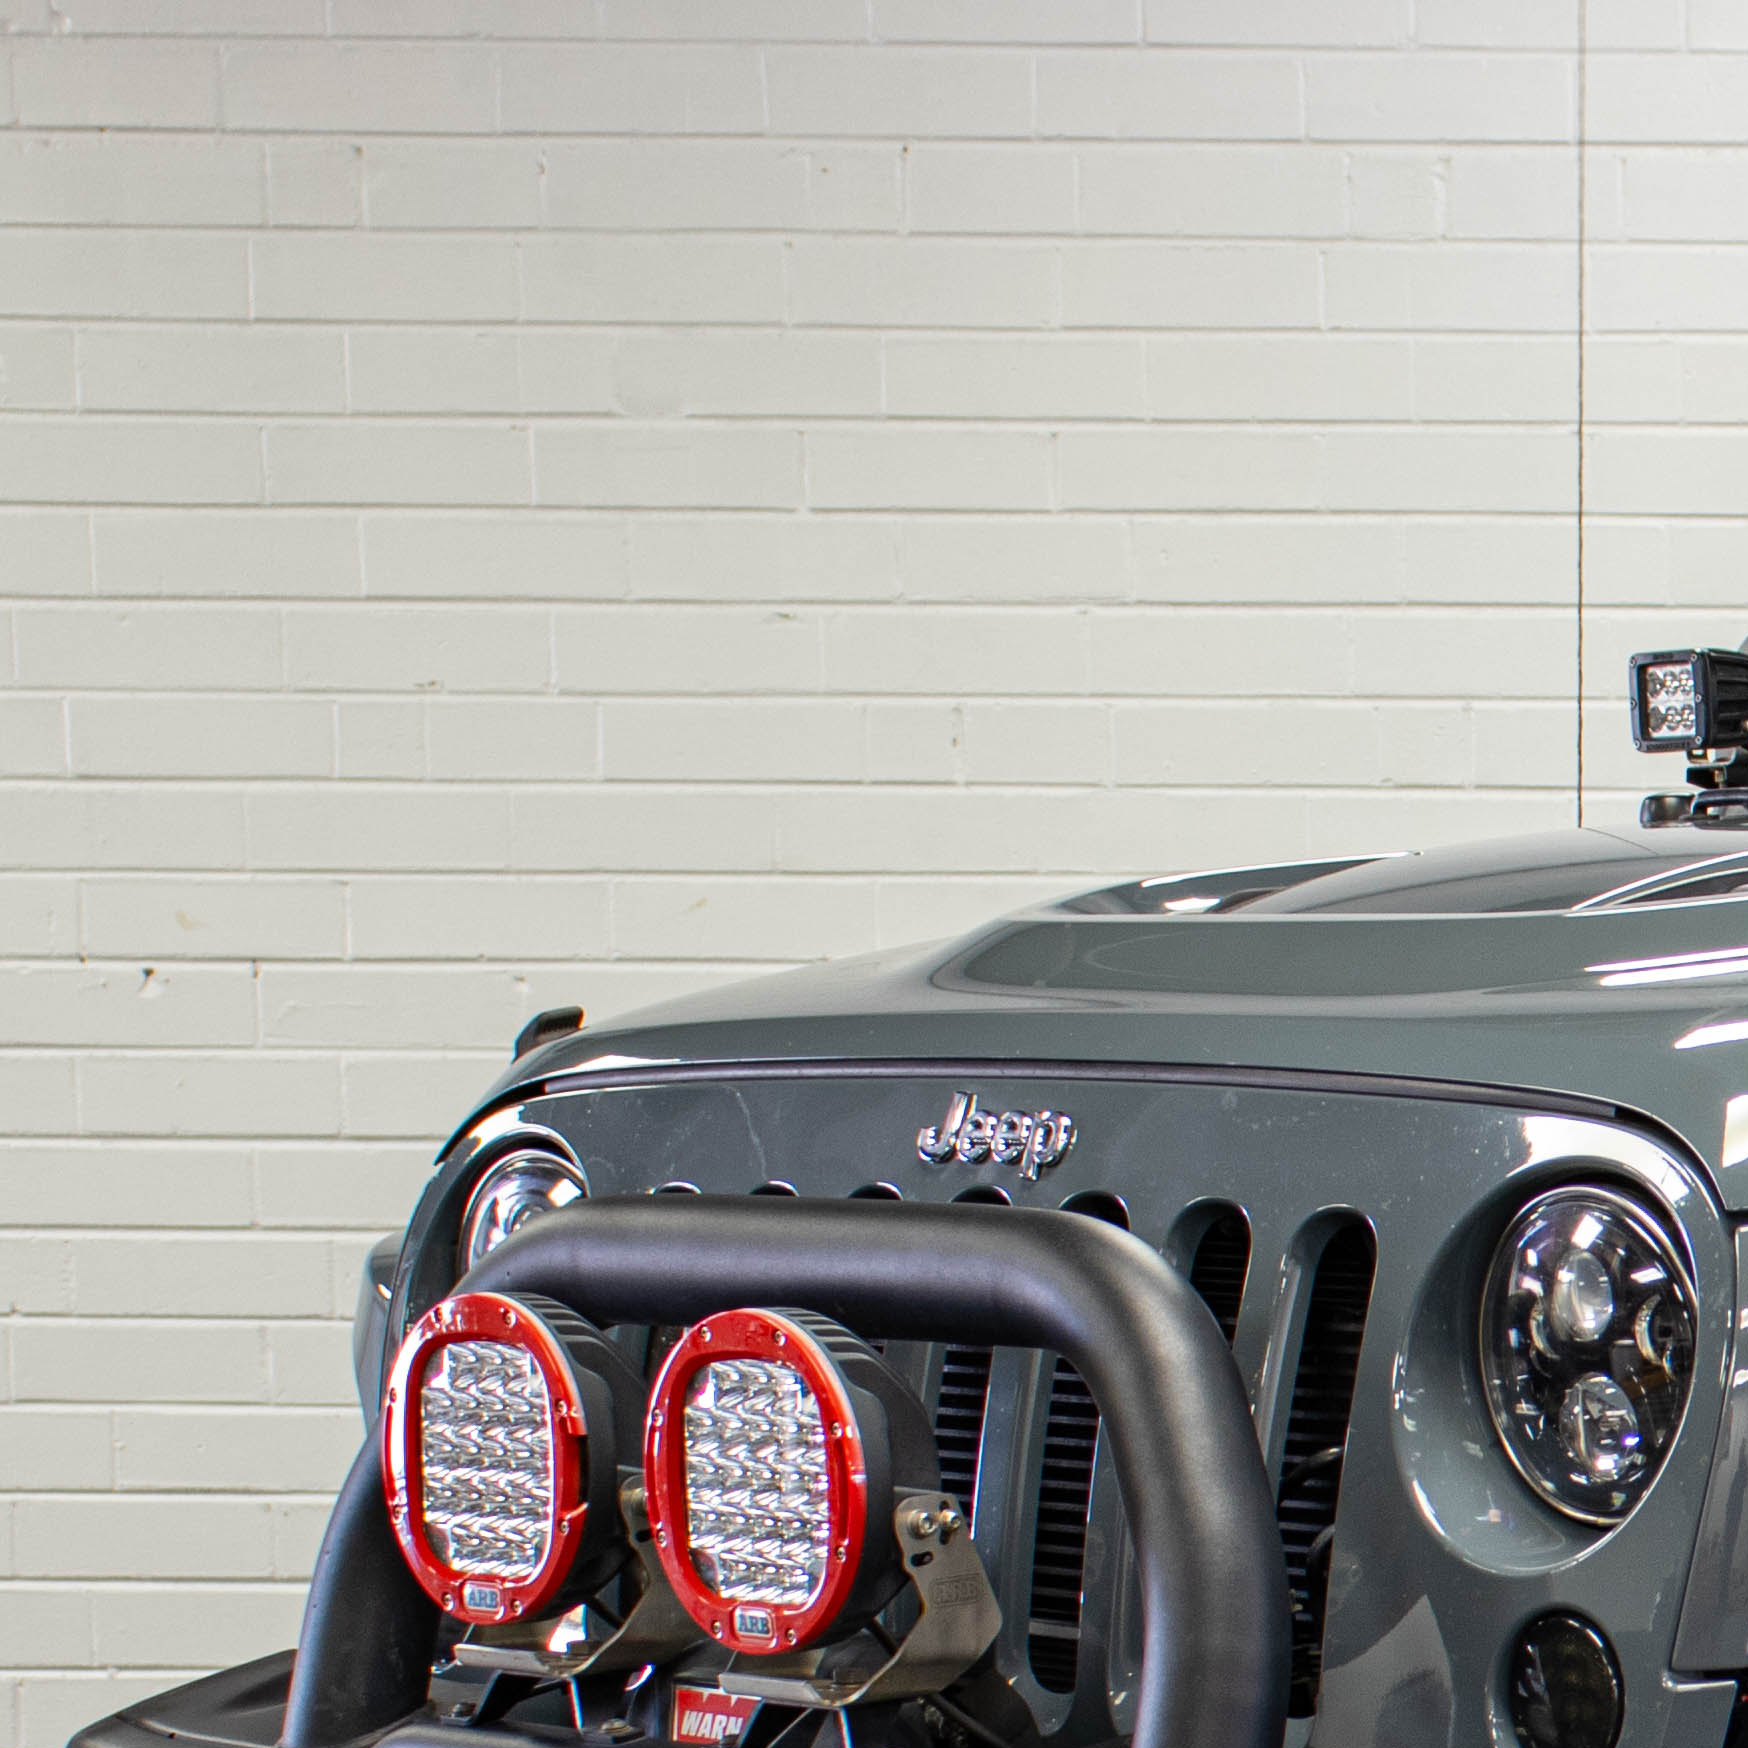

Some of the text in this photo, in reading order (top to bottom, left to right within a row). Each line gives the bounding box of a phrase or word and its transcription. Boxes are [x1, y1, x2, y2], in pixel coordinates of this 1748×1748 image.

[917, 1090, 1077, 1182] Jeep
[468, 1588, 499, 1610] ARB
[737, 1611, 770, 1635] ARB
[681, 1709, 743, 1740] WARN
